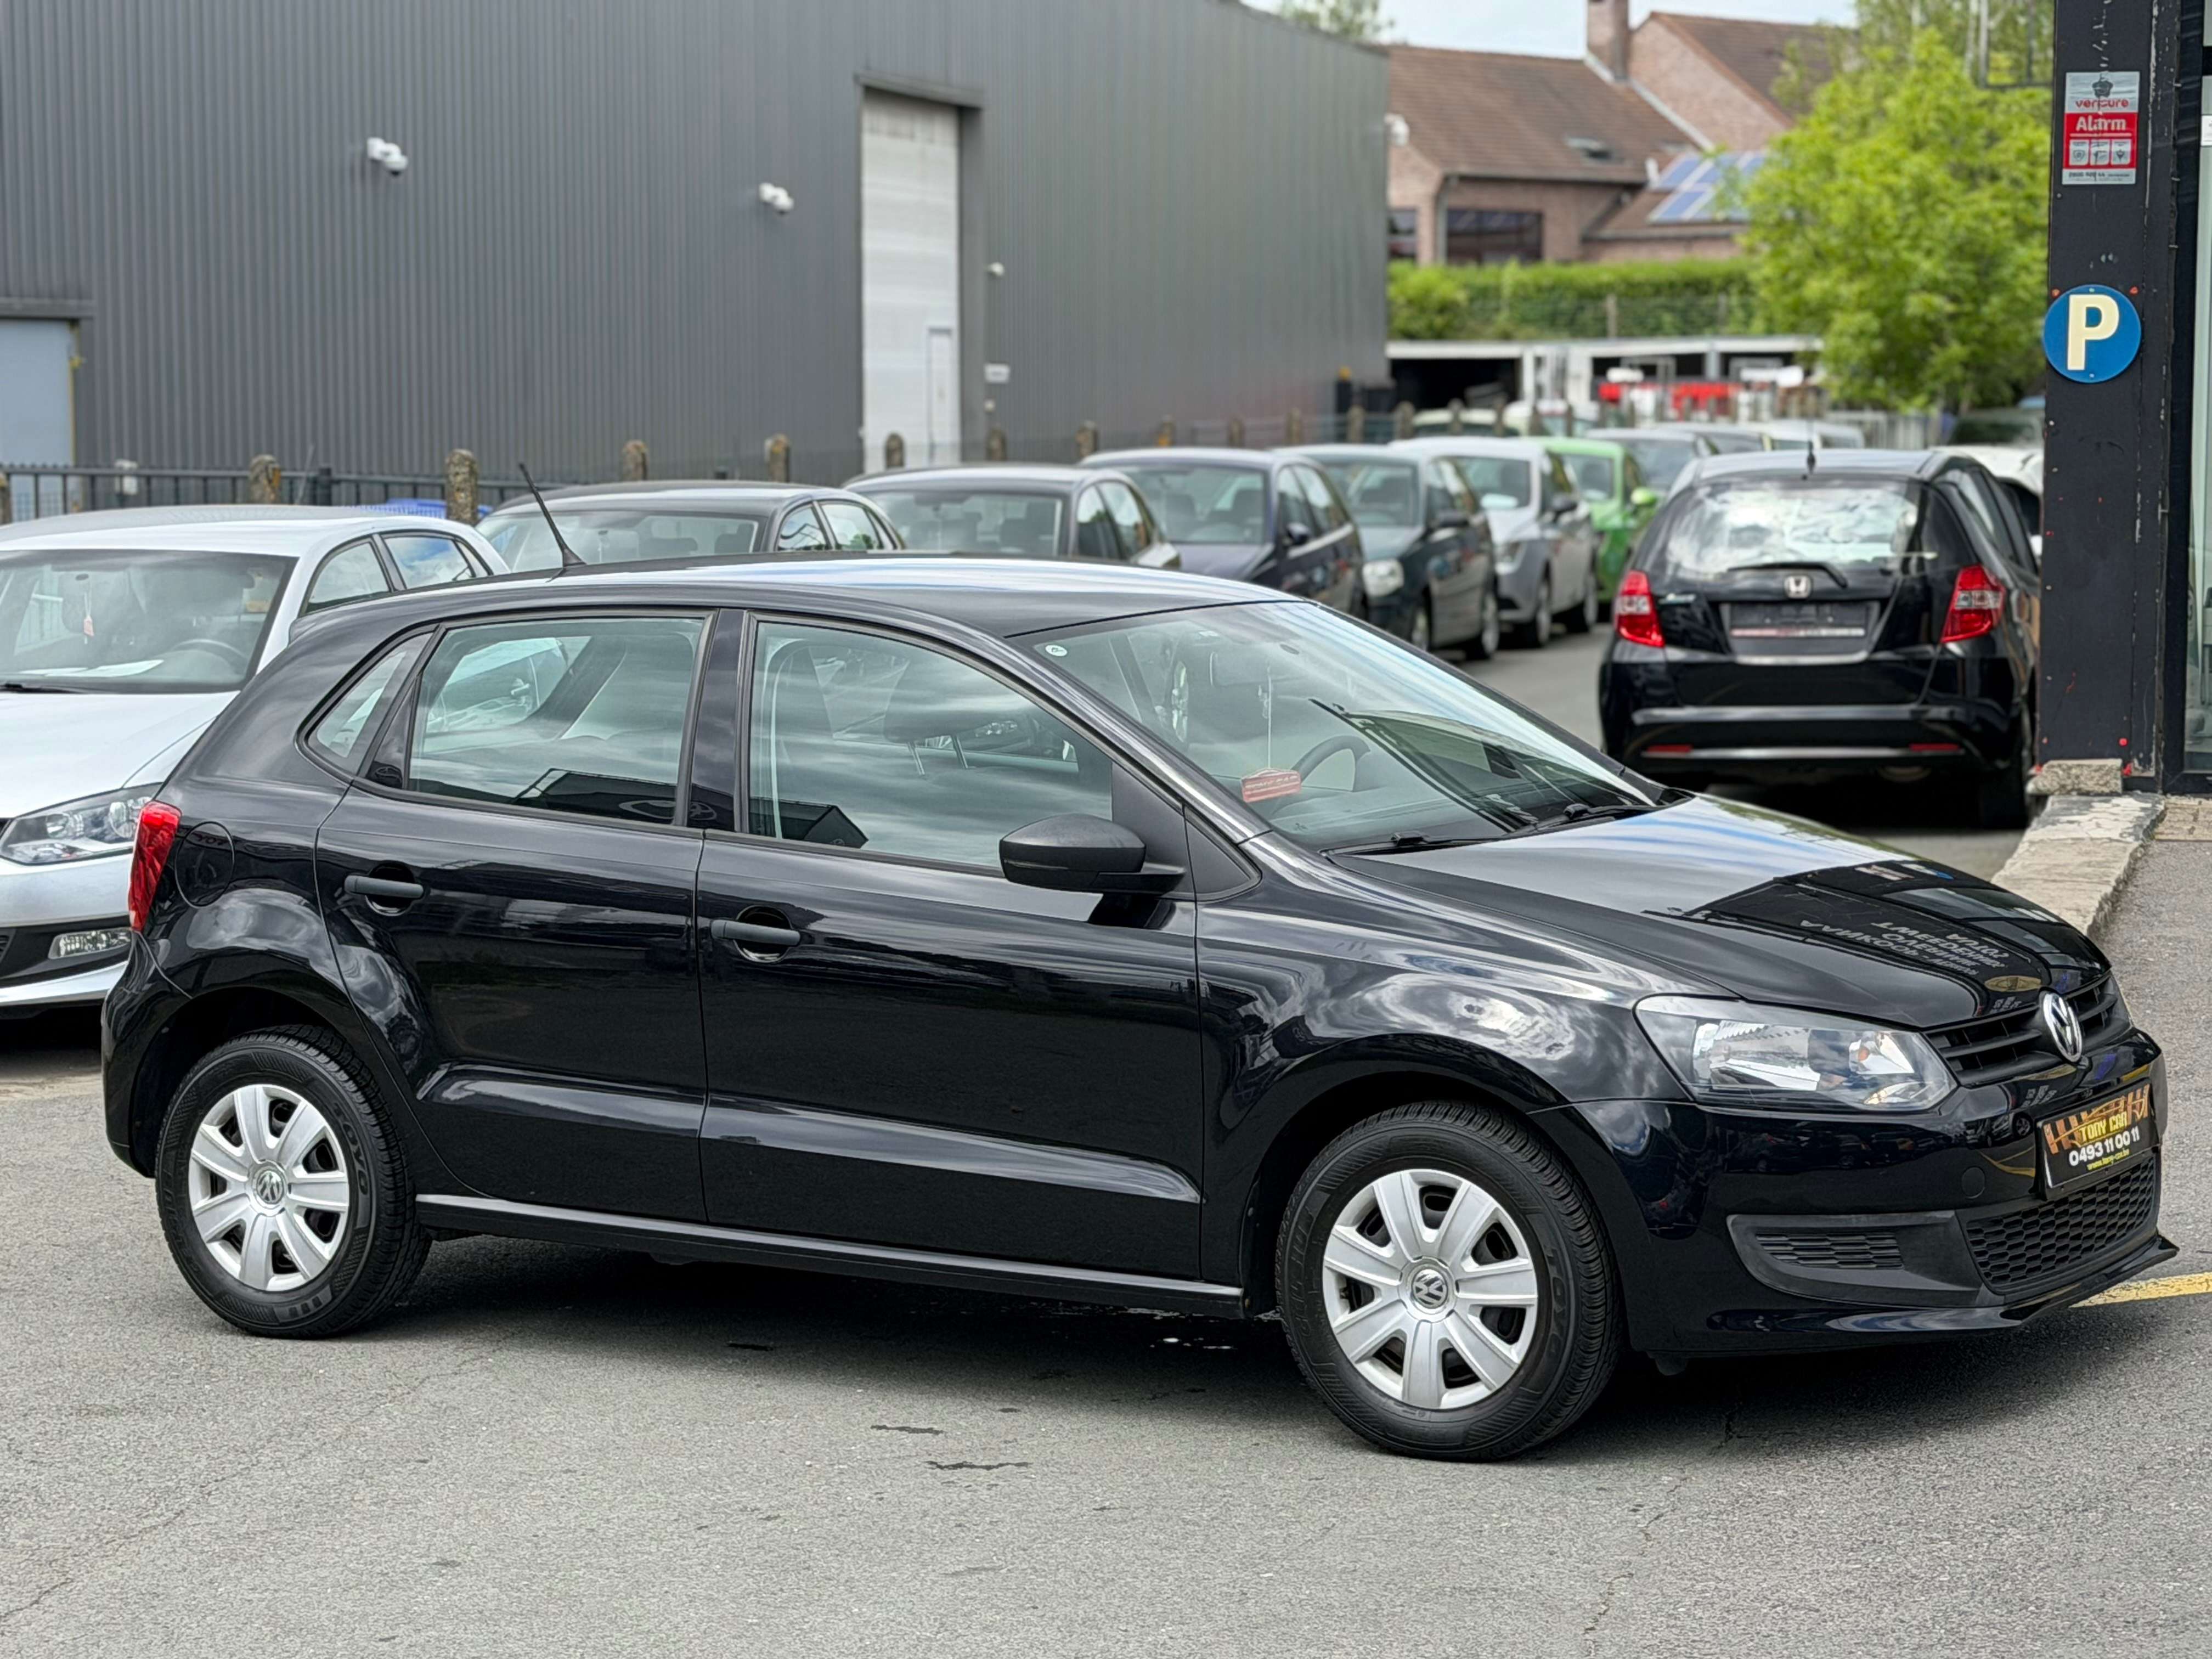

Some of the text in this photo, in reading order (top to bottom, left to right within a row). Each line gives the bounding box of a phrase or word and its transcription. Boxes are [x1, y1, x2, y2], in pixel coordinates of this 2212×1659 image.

[2076, 115, 2126, 132] Alarm
[2067, 294, 2120, 371] P
[2069, 1125, 2140, 1166] 0493 11 00 11
[2079, 1119, 2107, 1142] TONY
